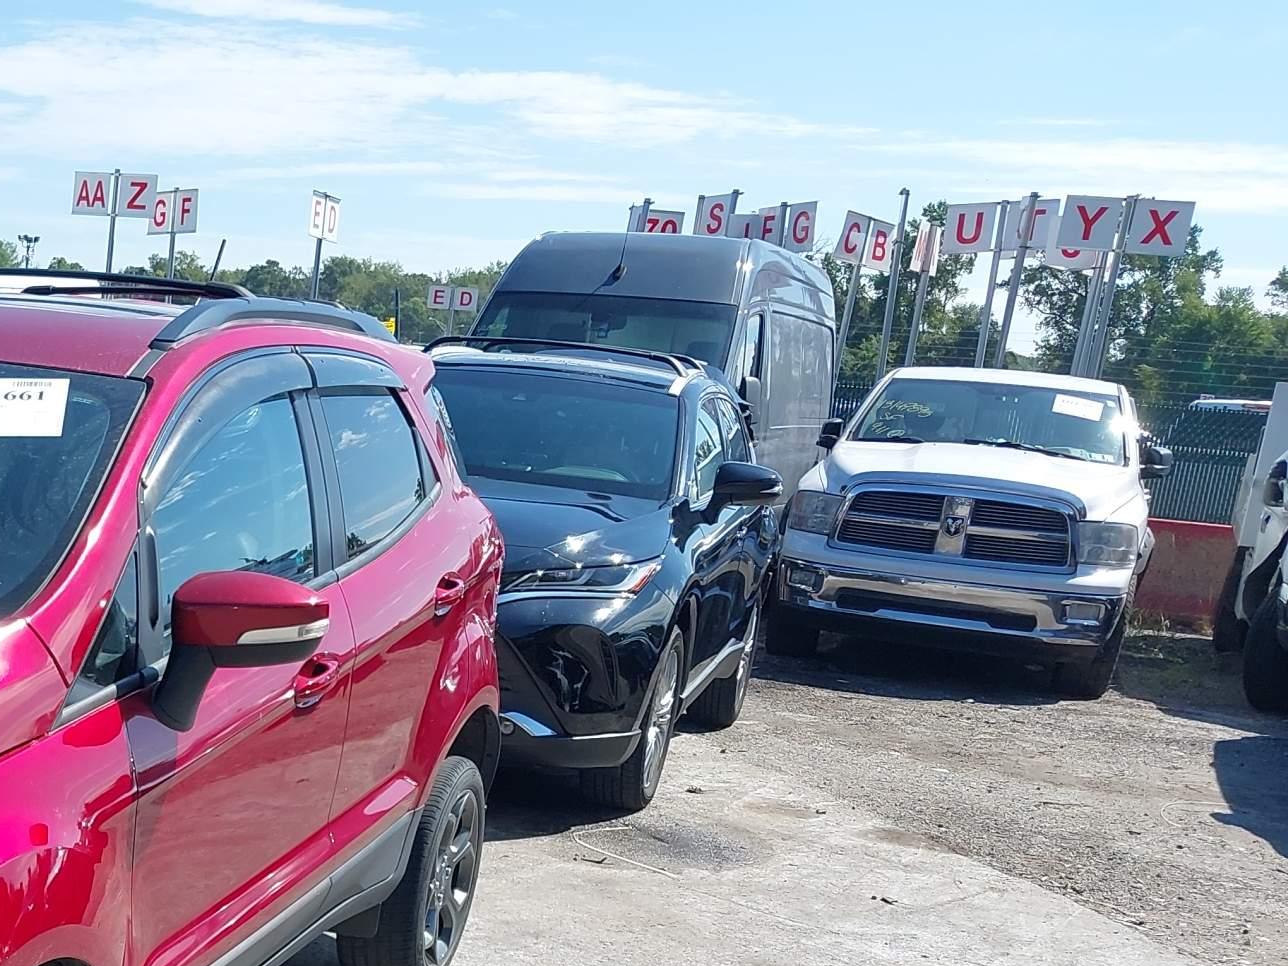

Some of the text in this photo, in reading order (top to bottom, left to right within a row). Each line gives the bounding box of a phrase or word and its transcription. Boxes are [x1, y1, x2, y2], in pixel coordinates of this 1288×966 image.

[76, 180, 148, 210] AA Z
[154, 197, 192, 227] G F
[312, 200, 336, 234] E D
[707, 203, 724, 235] S
[793, 211, 809, 243] G
[956, 212, 984, 244] U
[1077, 205, 1179, 246] Y X
[845, 222, 861, 254] C
[872, 229, 887, 261] B
[434, 290, 472, 306] E D
